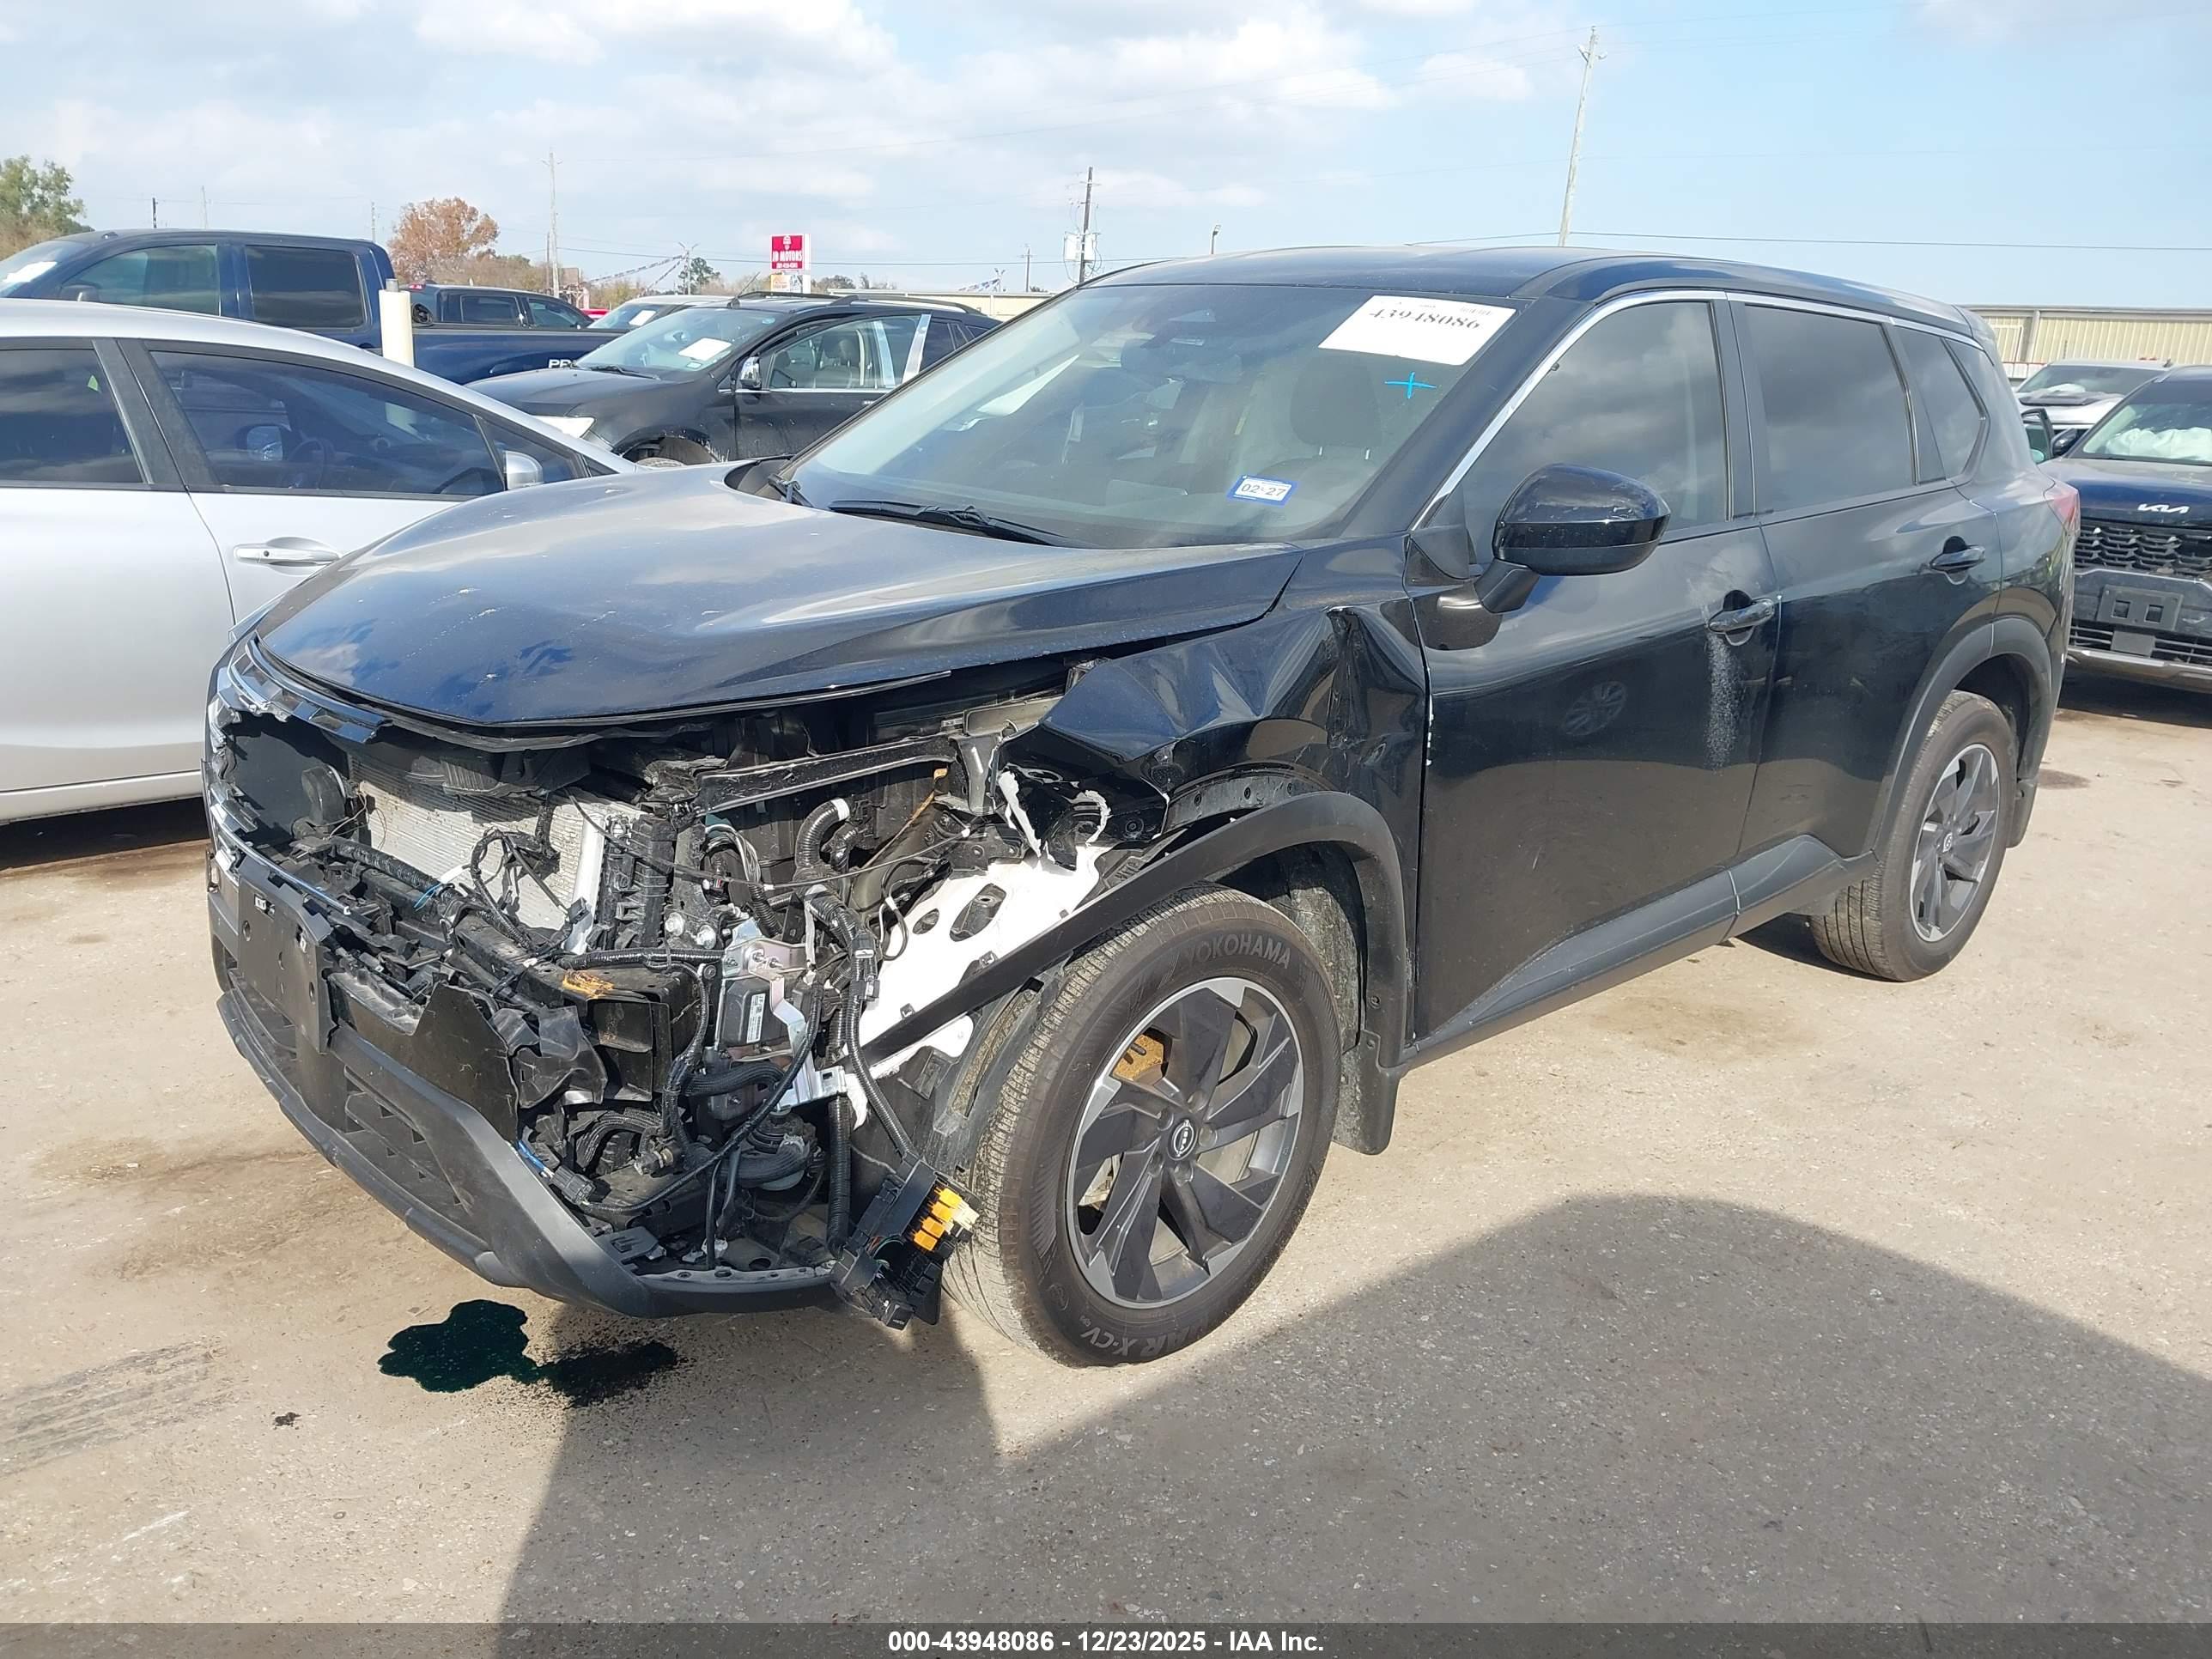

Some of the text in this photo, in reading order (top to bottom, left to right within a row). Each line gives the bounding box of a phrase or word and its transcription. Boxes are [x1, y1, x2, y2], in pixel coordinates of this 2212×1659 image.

[780, 250, 802, 262] MOTORS
[1369, 308, 1480, 330] 43948086
[2137, 503, 2190, 514] KIA
[1184, 933, 1291, 969] YOKOHAMA
